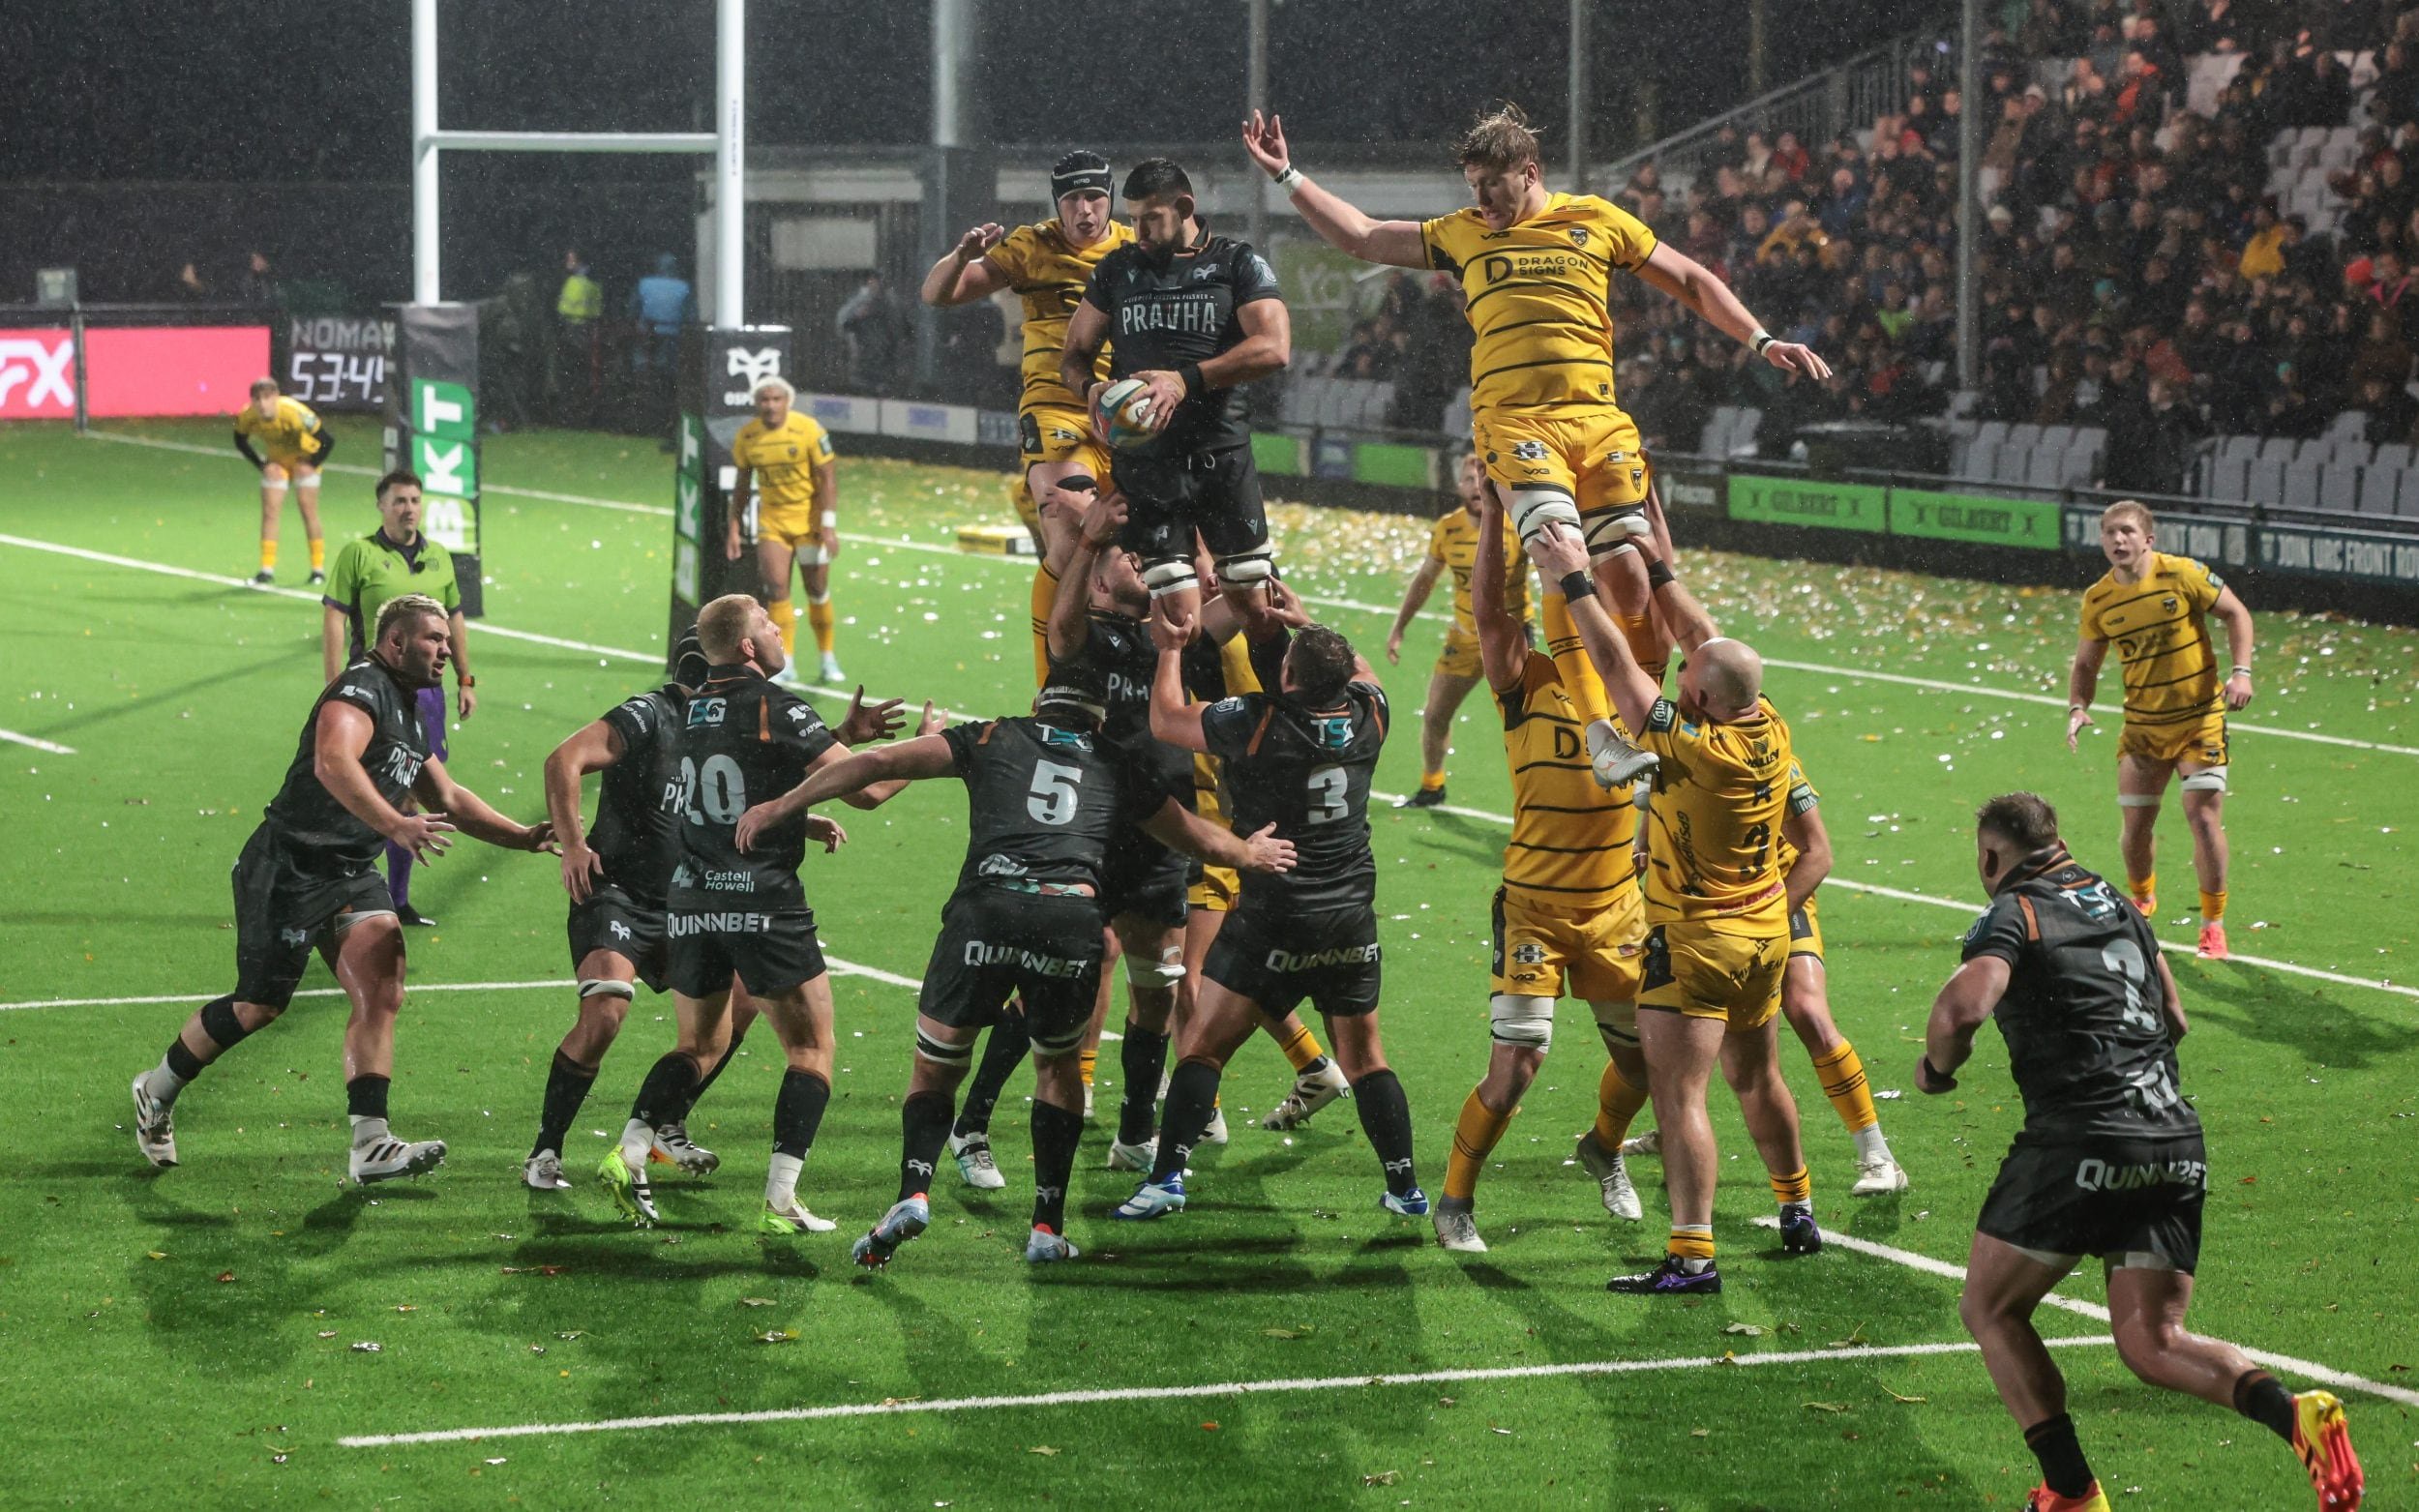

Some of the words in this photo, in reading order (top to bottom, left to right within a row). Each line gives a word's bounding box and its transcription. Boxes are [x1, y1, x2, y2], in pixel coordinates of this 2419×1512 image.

[1519, 255, 1588, 270] DRAGON
[1519, 265, 1566, 276] SIGNS
[291, 318, 384, 349] NOMA
[423, 384, 464, 549] BKT
[2278, 533, 2310, 568] JOIN
[2344, 540, 2392, 577] FRONT
[2395, 544, 2419, 579] RO
[1108, 672, 1150, 701] PRA
[688, 697, 727, 726] TSG
[1027, 759, 1084, 825] 5
[1308, 762, 1349, 824] 3
[704, 871, 751, 882] Castell
[705, 880, 755, 893] Howell
[668, 912, 773, 939] QUINNBET
[965, 940, 1088, 979] QUINNBET
